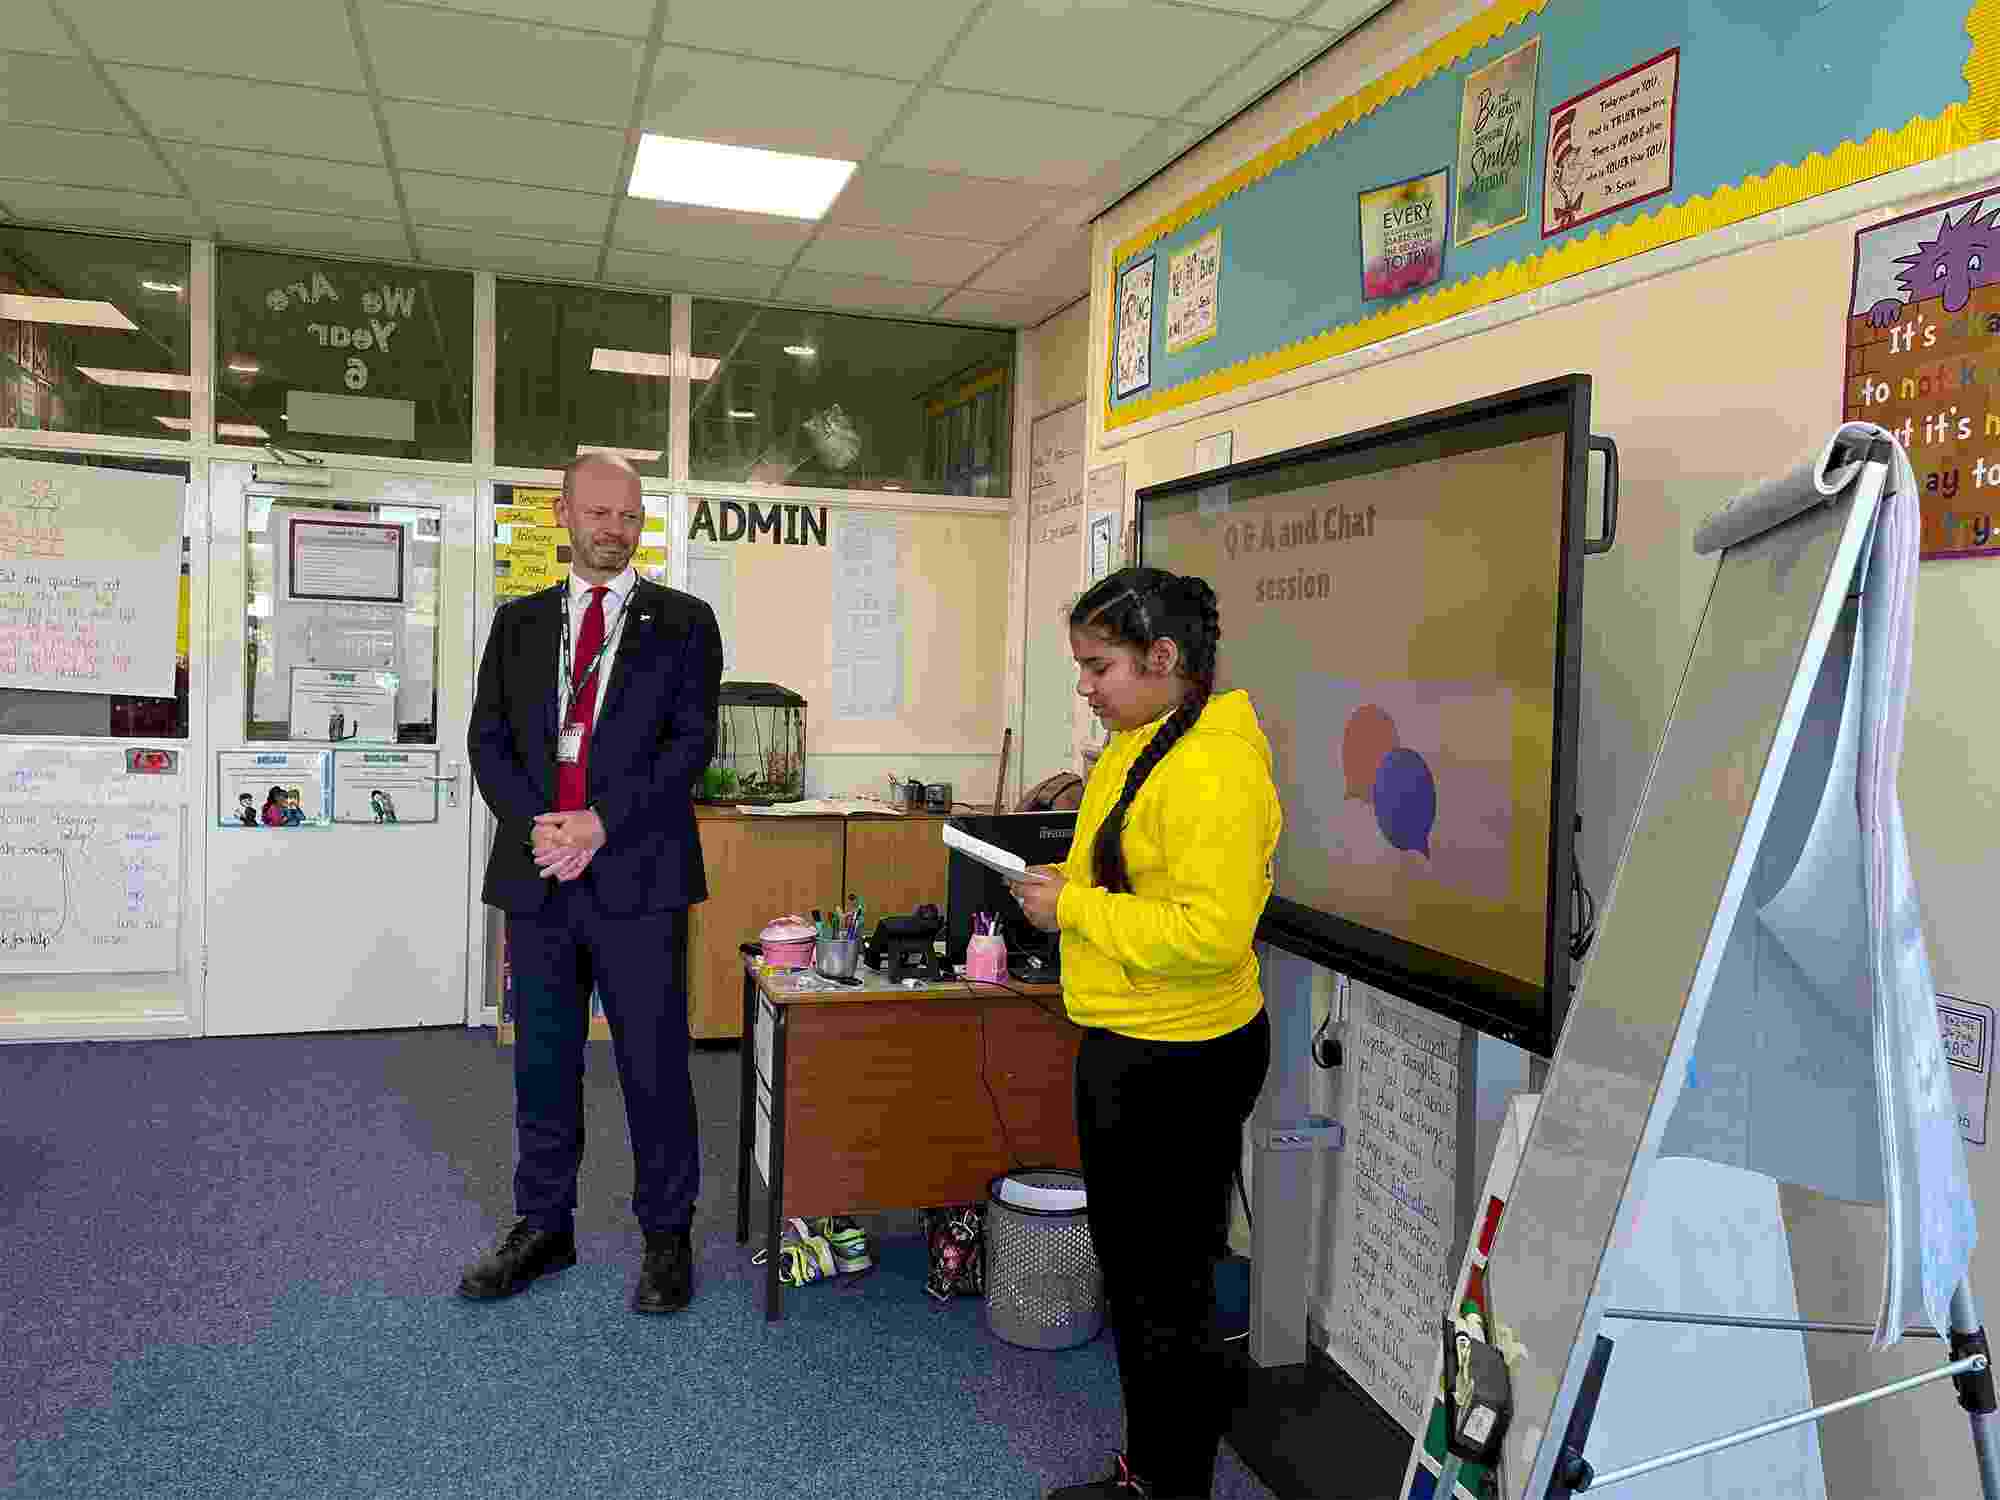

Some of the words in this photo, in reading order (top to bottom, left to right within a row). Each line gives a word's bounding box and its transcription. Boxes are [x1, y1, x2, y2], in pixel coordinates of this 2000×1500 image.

[1384, 200, 1432, 229] EVERY
[1888, 315, 1937, 353] It's
[1862, 378, 1889, 406] to
[1900, 366, 1951, 399] not
[1925, 405, 1972, 445] it's
[1972, 457, 2000, 488] to
[688, 500, 829, 546] ADMIN
[1280, 504, 1317, 549] and
[1324, 503, 1377, 543] Chat
[1256, 568, 1331, 602] session
